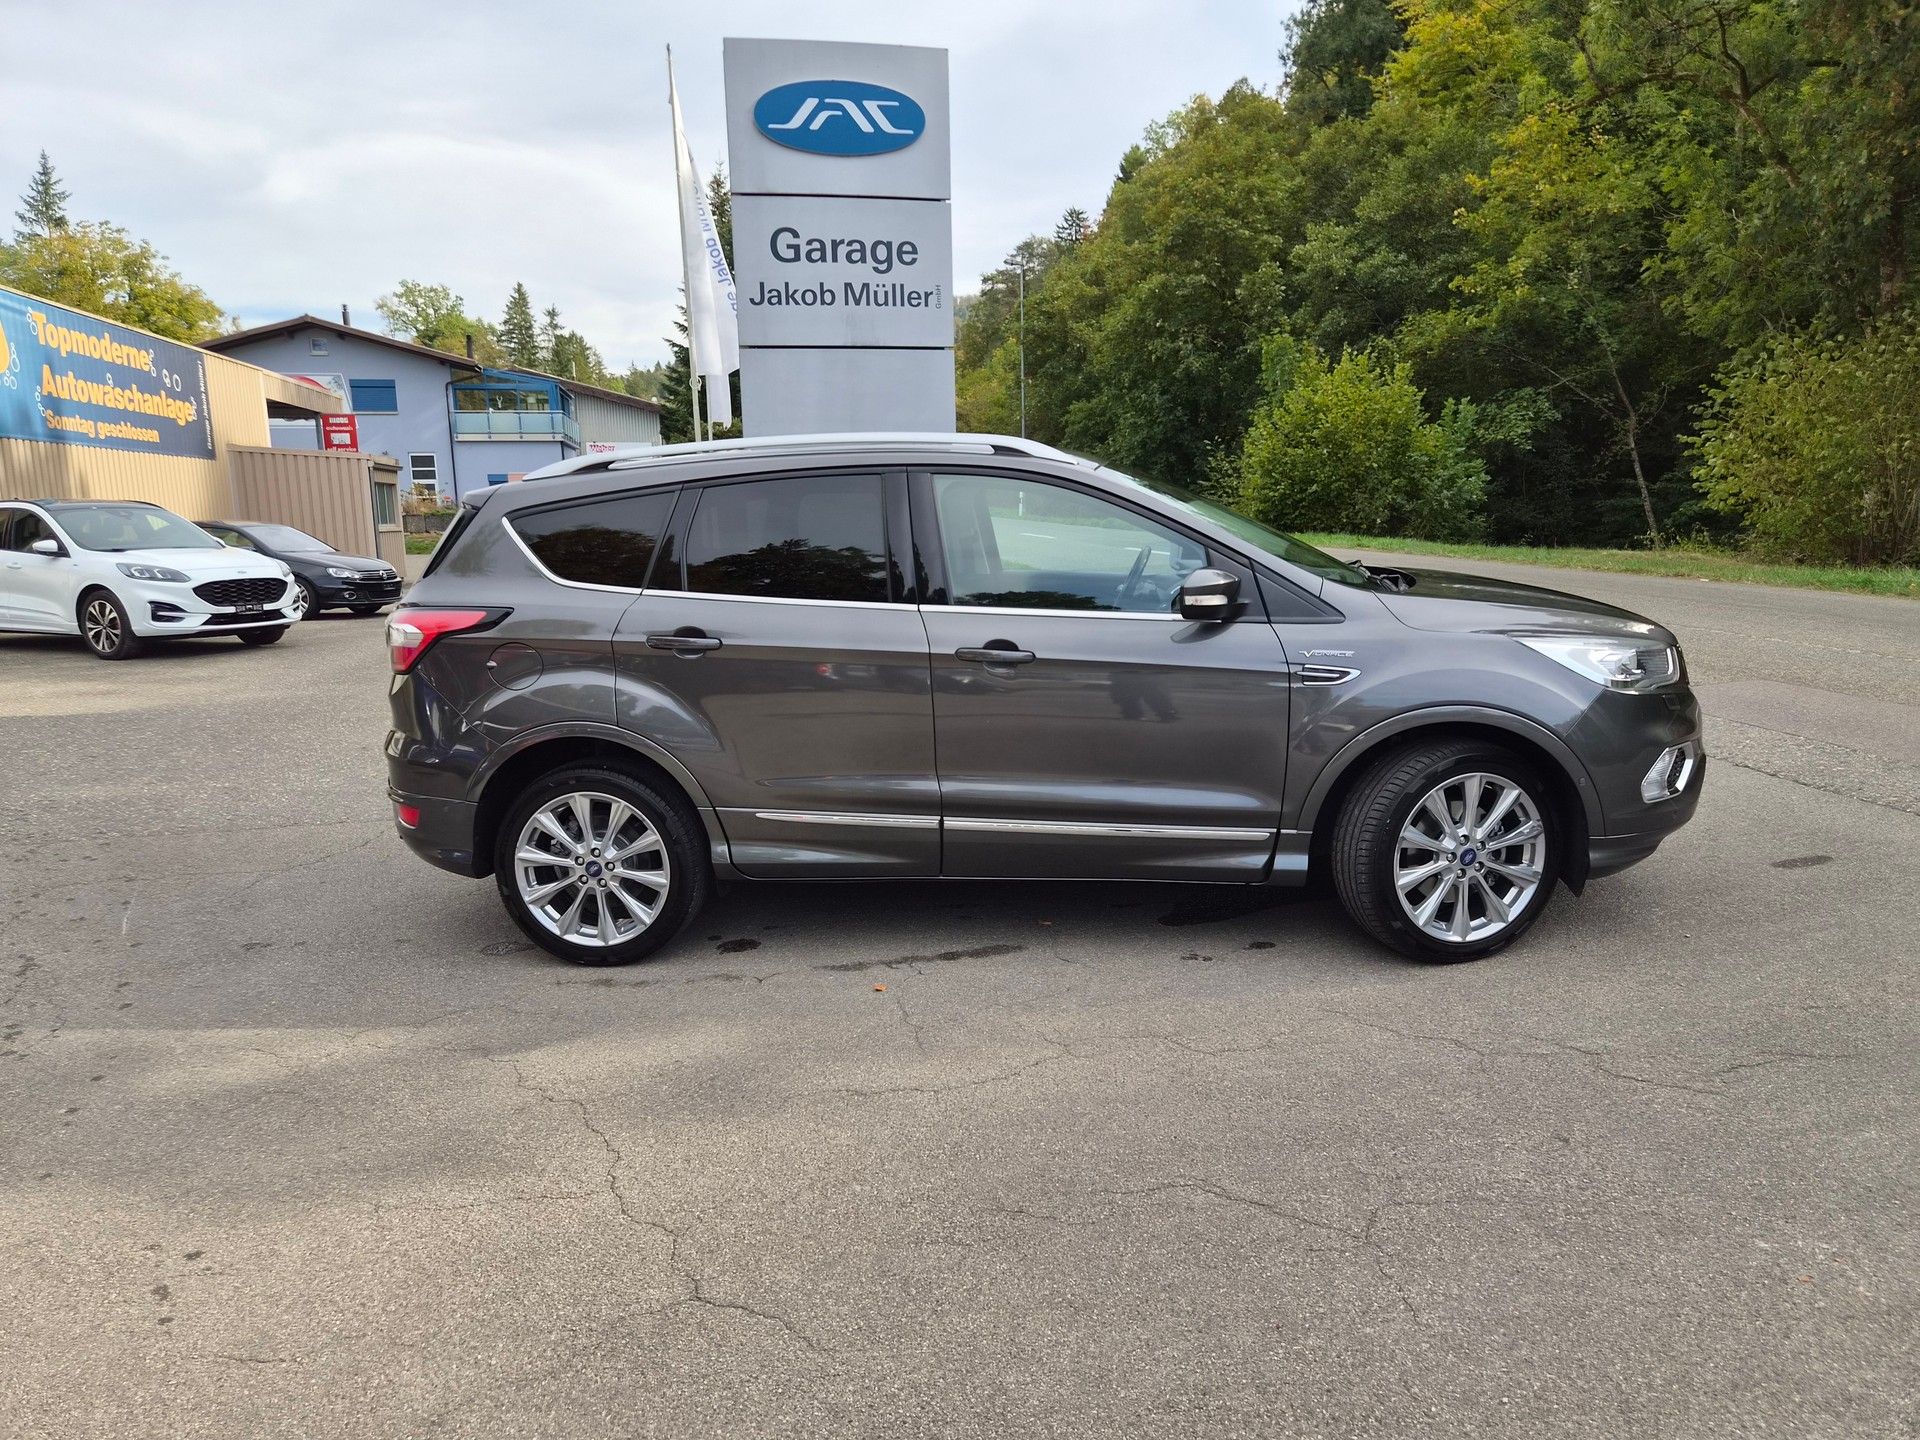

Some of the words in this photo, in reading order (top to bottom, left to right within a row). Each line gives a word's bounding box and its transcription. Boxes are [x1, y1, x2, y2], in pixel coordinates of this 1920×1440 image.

[706, 238, 732, 287] Jakob
[770, 227, 919, 274] Garage
[749, 281, 836, 306] Jakob
[844, 282, 934, 308] Müller
[32, 311, 151, 372] Topmoderne
[42, 364, 194, 426] Autowaschanlage
[45, 410, 95, 438] Sonntag
[98, 421, 160, 443] geschlossen
